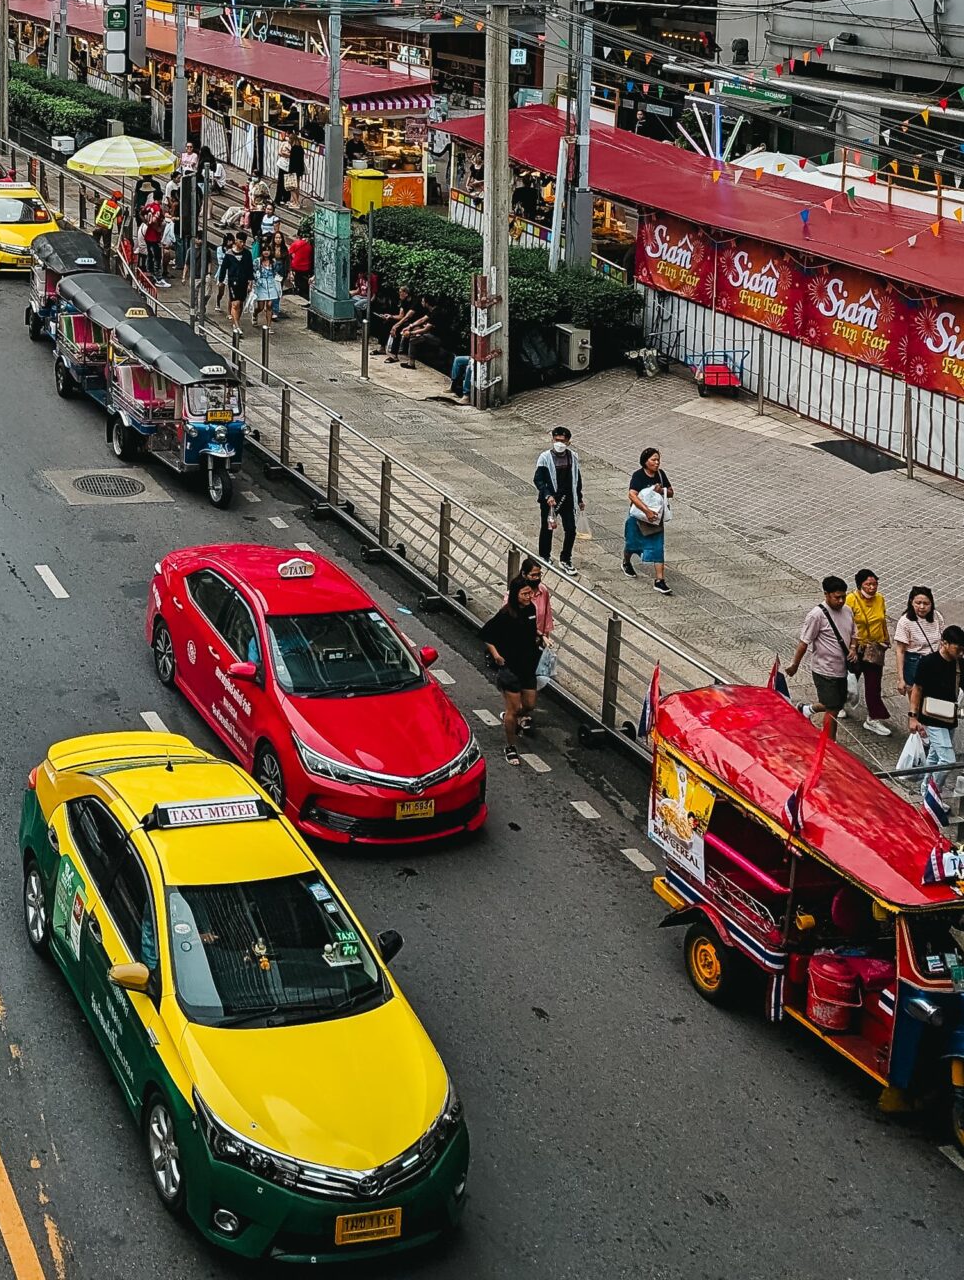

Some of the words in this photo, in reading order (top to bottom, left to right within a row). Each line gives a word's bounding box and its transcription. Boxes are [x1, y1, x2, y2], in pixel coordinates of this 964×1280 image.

[514, 50, 524, 58] 28
[645, 225, 693, 269] Siam
[657, 261, 677, 279] Fun
[679, 268, 700, 287] Fair
[729, 251, 780, 297] Siam
[739, 290, 761, 309] Fun
[764, 297, 788, 317] Fair
[818, 278, 881, 330] Siam
[832, 319, 858, 342] Fun
[862, 328, 890, 351] Fair
[289, 565, 307, 576] TAXI
[169, 803, 256, 822] TAXI-METER
[415, 800, 433, 810] 5934
[653, 823, 670, 845] BKK
[669, 837, 701, 870] CEREAL
[336, 931, 356, 941] TAXI
